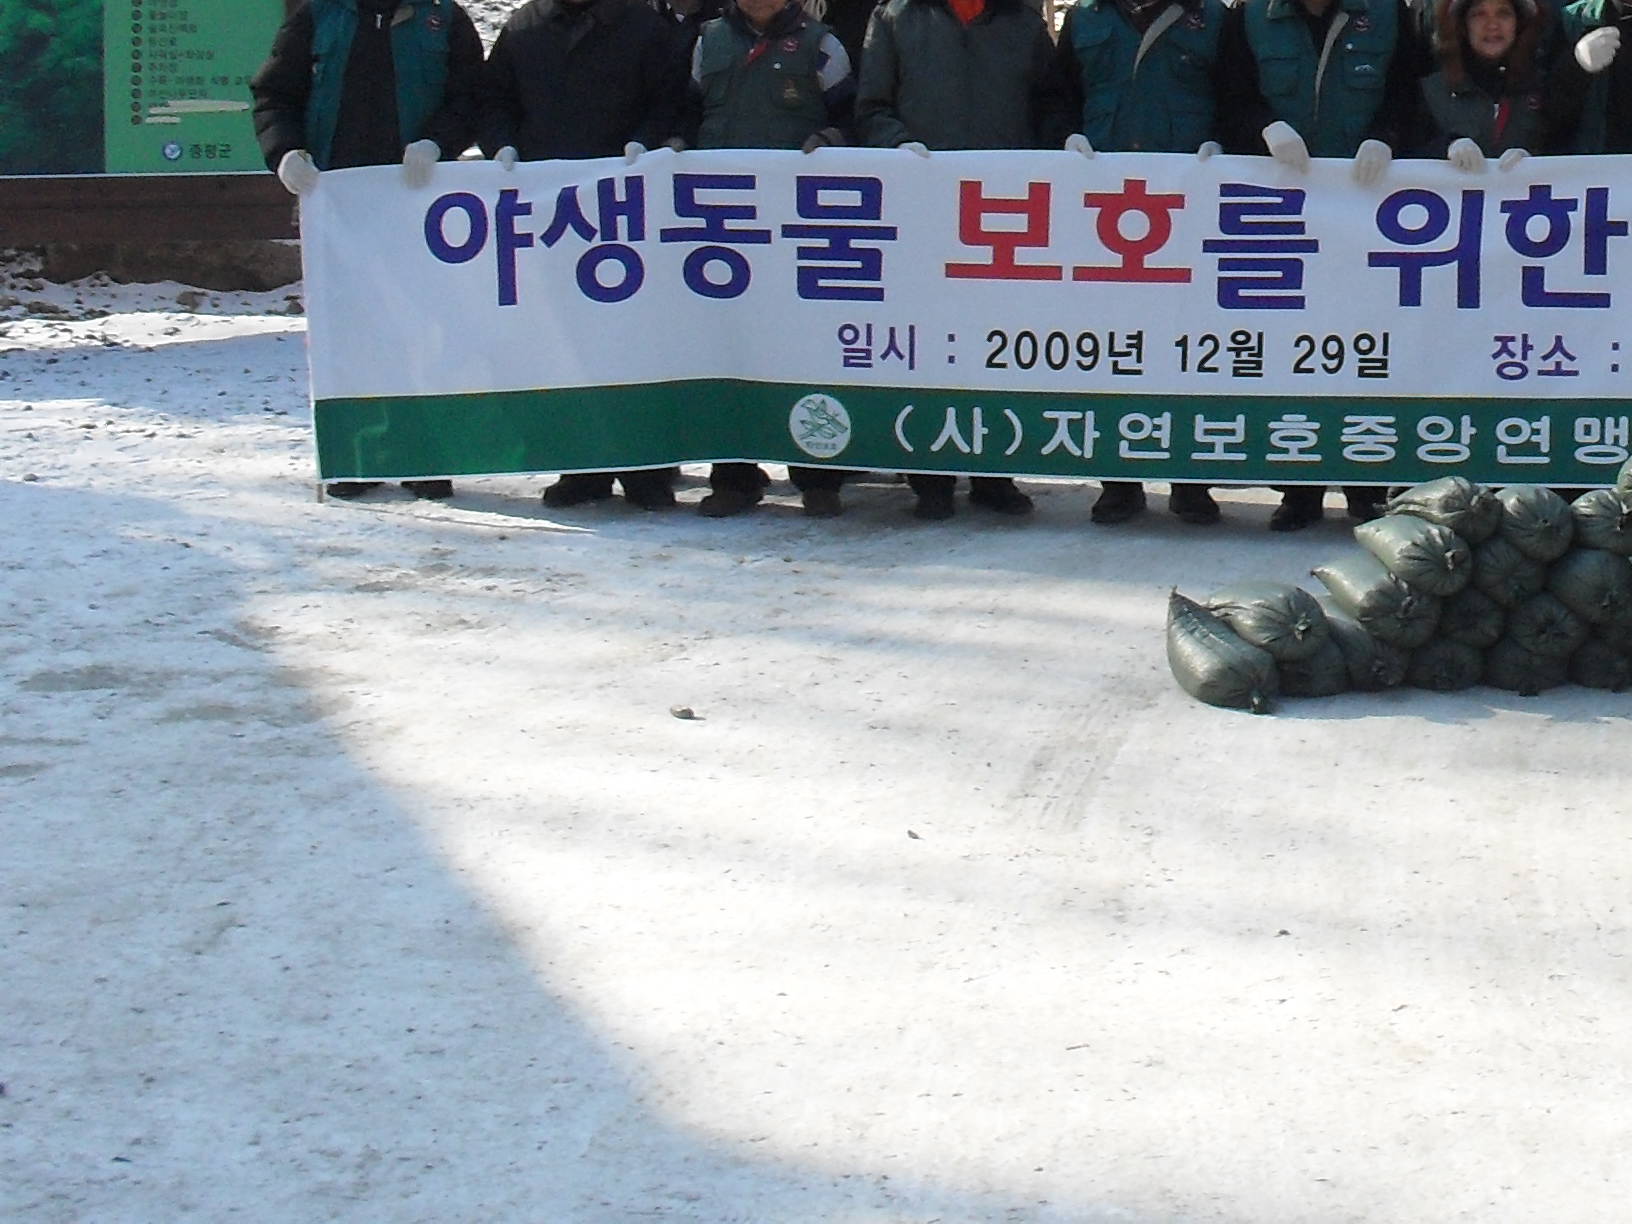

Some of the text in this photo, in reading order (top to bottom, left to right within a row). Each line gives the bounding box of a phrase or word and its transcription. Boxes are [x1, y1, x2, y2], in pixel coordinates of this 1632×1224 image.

[425, 174, 897, 306] 야생동물
[945, 179, 1319, 309] 보호를
[1368, 185, 1628, 308] 위한
[838, 324, 915, 370] 일시
[986, 330, 1143, 375] 2009년
[1175, 330, 1263, 377] 12월
[1294, 332, 1389, 378] 29일
[1492, 334, 1579, 380] 장소
[895, 405, 1630, 465] (사)자연보호중앙연맹
